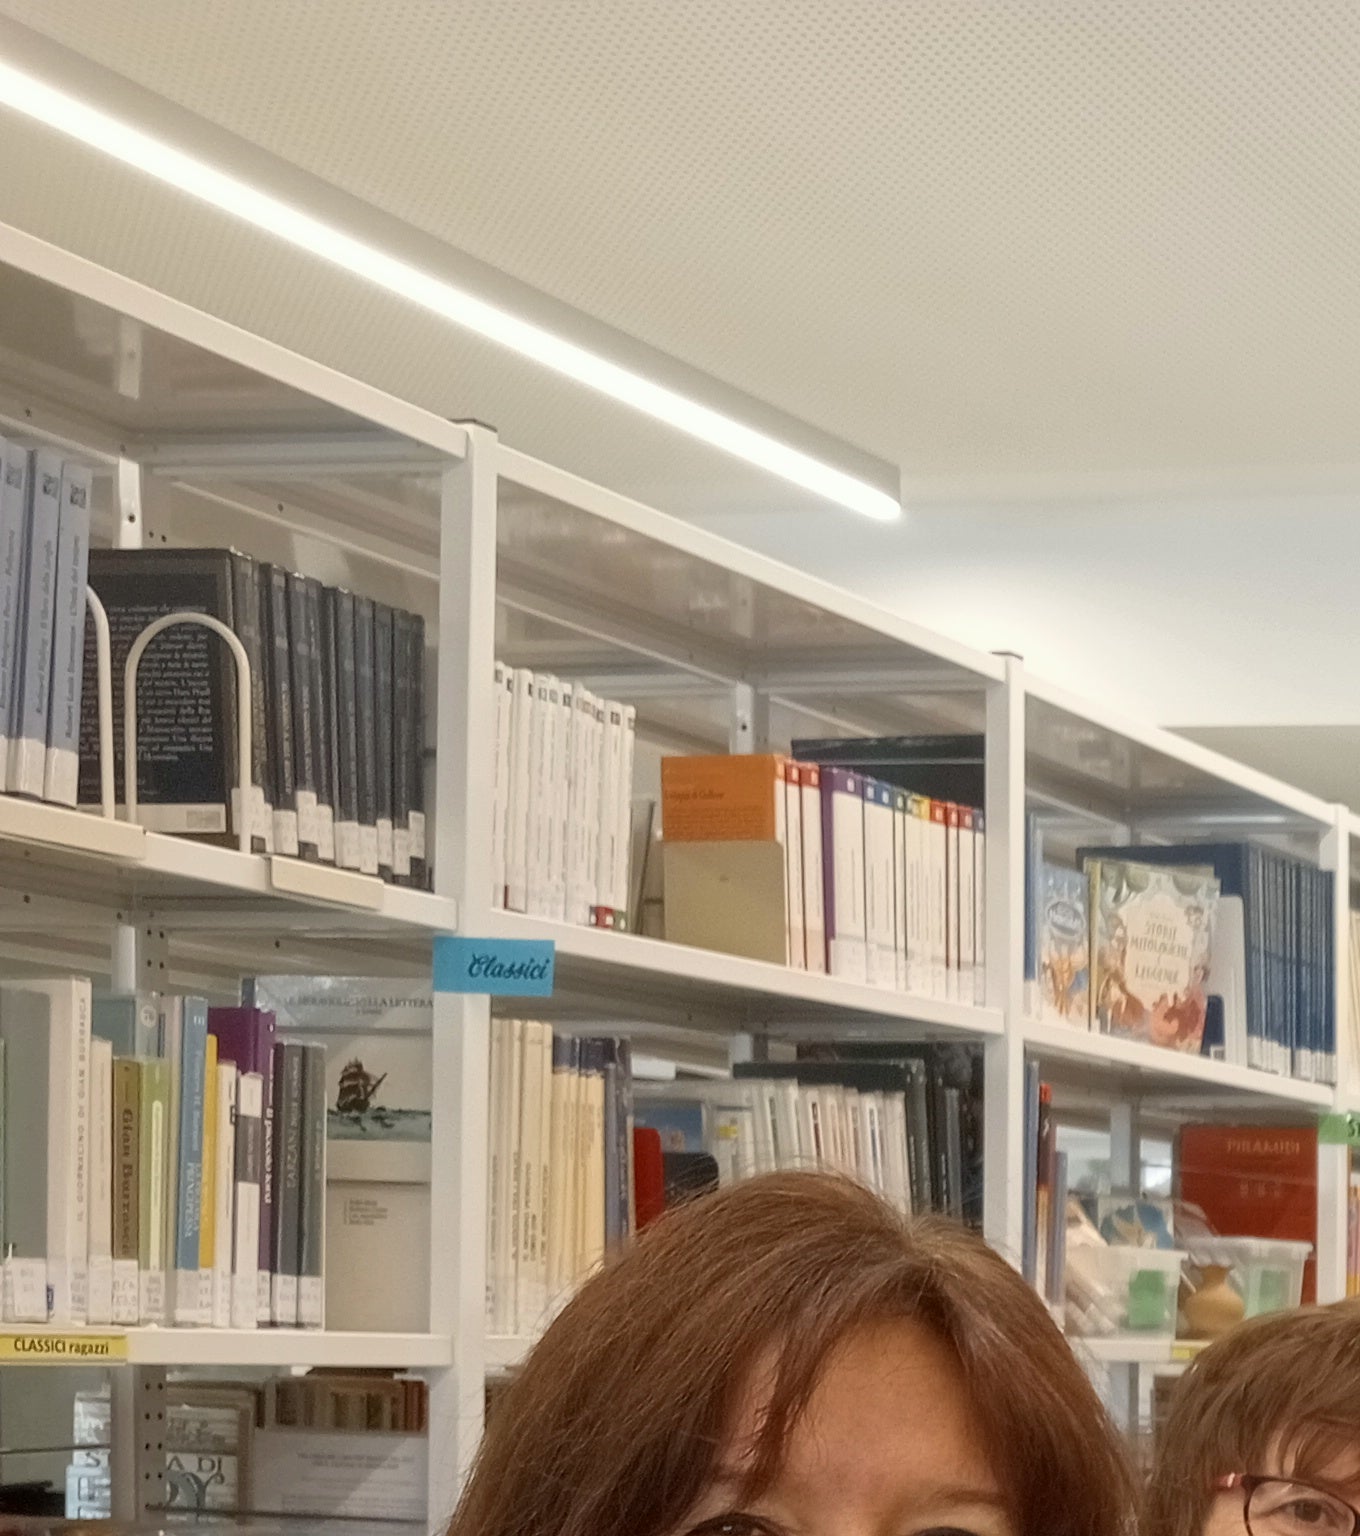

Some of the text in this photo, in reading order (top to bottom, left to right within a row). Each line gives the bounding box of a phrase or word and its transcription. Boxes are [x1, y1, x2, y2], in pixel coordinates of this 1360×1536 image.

[467, 953, 550, 980] Classici
[13, 1337, 109, 1356] CLASSICI ragazzi
